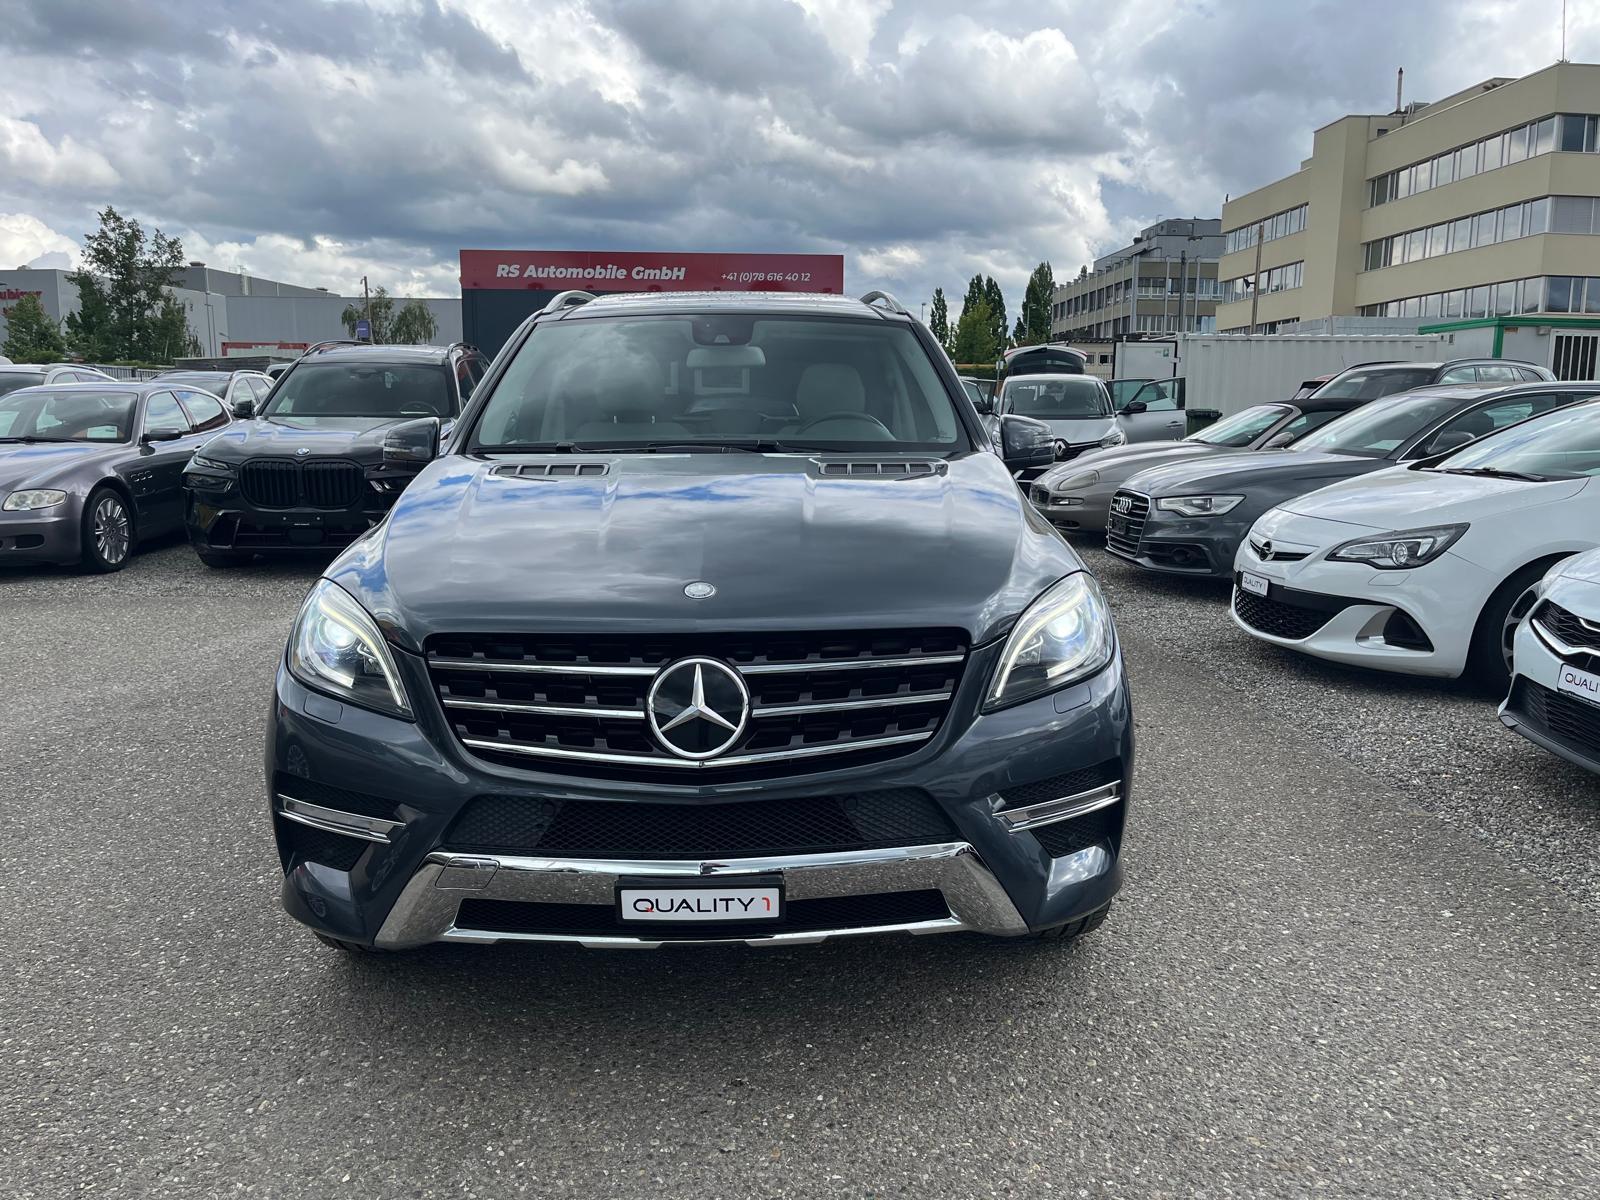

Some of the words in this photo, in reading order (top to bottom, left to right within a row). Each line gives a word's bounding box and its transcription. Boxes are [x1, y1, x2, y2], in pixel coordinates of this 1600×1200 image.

[496, 264, 520, 278] RS
[523, 264, 627, 279] Automobile
[631, 266, 686, 280] GmbH
[721, 272, 737, 281] +41
[739, 271, 765, 283] (0)78
[767, 272, 783, 281] 616
[785, 272, 799, 281] 40
[801, 272, 811, 281] 12
[1565, 672, 1600, 693] QUALI
[633, 897, 755, 913] QUALITY
[762, 896, 771, 912] 1
